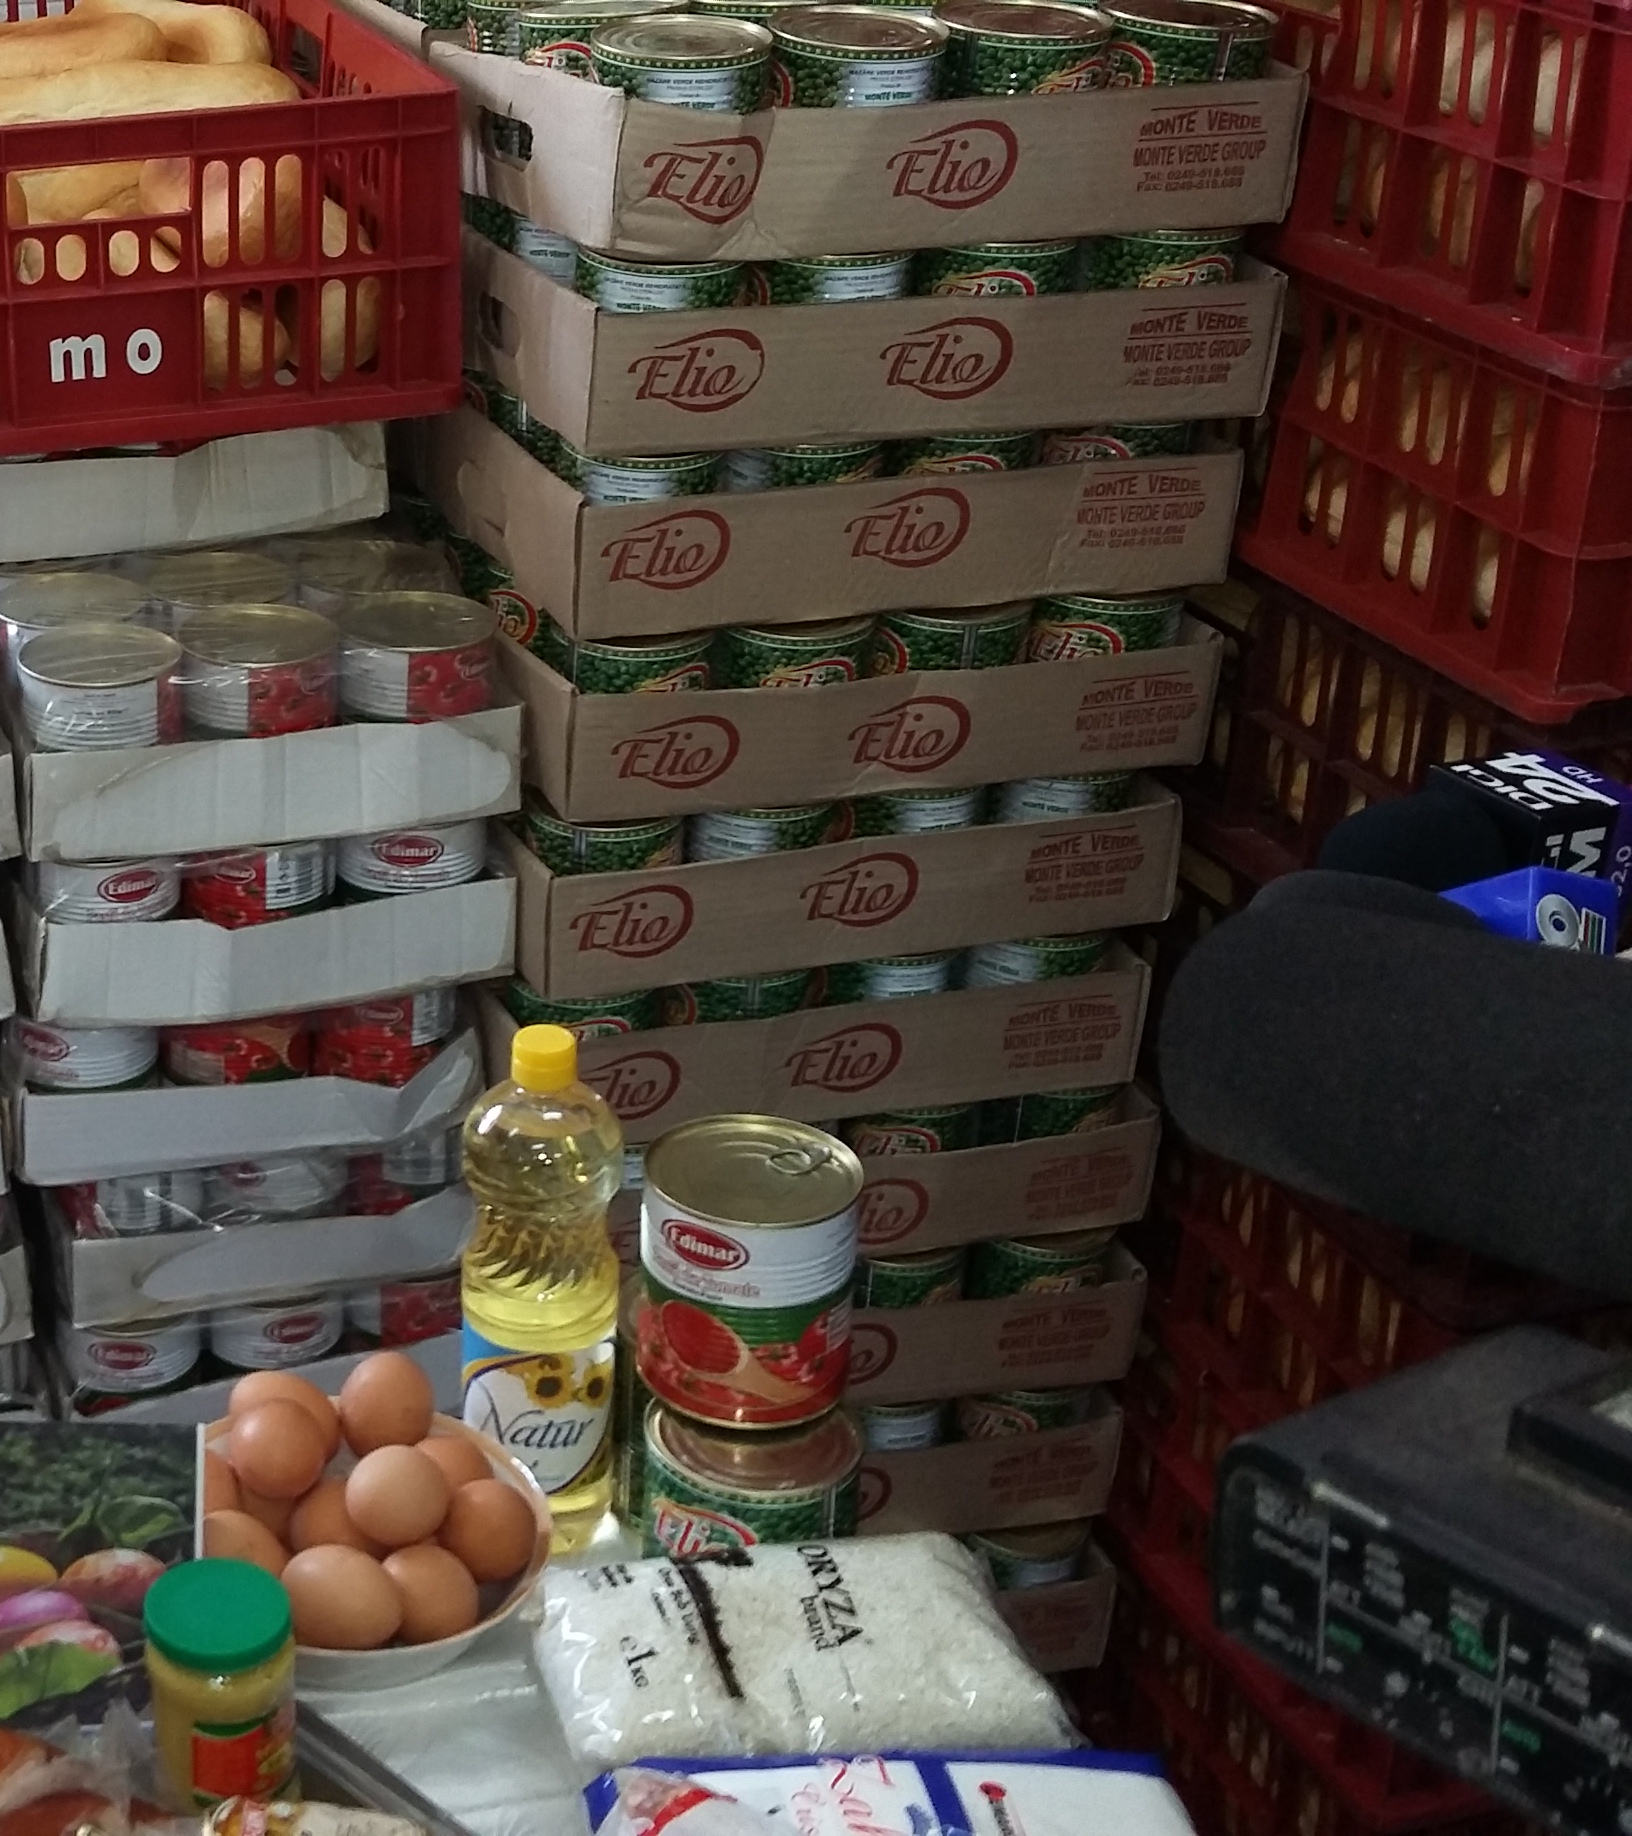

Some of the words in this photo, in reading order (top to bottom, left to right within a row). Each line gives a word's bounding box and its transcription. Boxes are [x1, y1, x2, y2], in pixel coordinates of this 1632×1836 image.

[1140, 111, 1198, 136] MONTE
[1207, 110, 1262, 130] VERDE
[886, 140, 1001, 197] Elio
[1133, 145, 1176, 168] MONTE
[1178, 142, 1219, 165] VERDE
[1221, 139, 1267, 161] GROUP
[644, 150, 752, 209] Elio
[1129, 312, 1188, 335] MONTE
[1196, 311, 1249, 331] VERDE
[627, 348, 746, 402] Elio
[880, 334, 997, 387] Elio
[1123, 344, 1165, 364] MONTE
[1167, 341, 1207, 361] VERDE
[1208, 338, 1252, 360] GROUP
[1082, 475, 1139, 497] MONTE
[1148, 474, 1201, 493] VERDE
[844, 506, 956, 557] Elio
[1076, 506, 1118, 525] MONTE
[1120, 504, 1161, 523] VERDE
[1162, 501, 1206, 521] GROUP
[600, 528, 712, 582] Elio
[1081, 682, 1137, 706] MONTE
[1144, 680, 1194, 698] VERDE
[611, 731, 716, 780] Elio
[848, 711, 955, 764] Elio
[1485, 752, 1620, 807] 24
[1562, 765, 1605, 784] HD
[1030, 836, 1084, 859] MONTE
[800, 870, 904, 920] Elio
[570, 901, 678, 952] Elio
[785, 1039, 881, 1087] Elio
[472, 1378, 594, 1450] Natur
[797, 1544, 864, 1648] ORYZA
